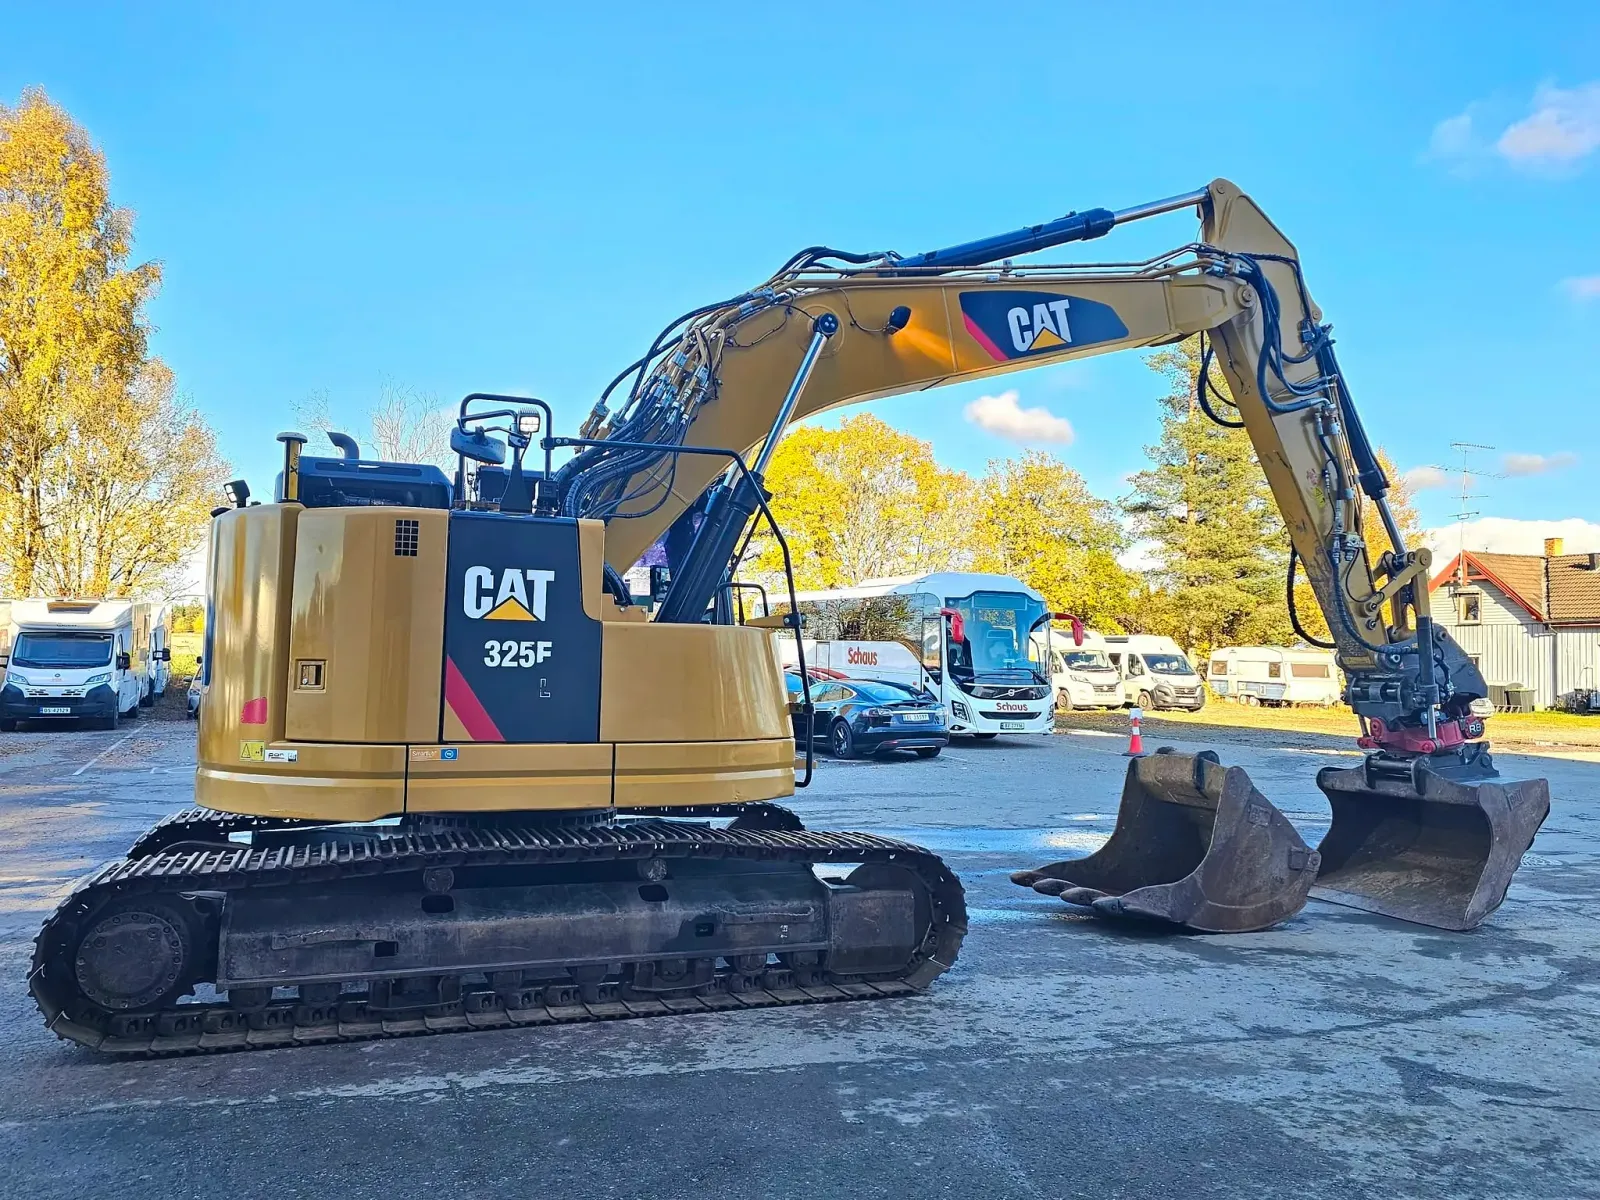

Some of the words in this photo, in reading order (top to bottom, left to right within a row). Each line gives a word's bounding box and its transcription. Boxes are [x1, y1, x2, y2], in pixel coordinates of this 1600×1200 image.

[1007, 299, 1072, 352] CAT
[463, 565, 555, 622] CAT
[484, 640, 553, 668] 325F
[848, 645, 878, 666] Schaus
[996, 701, 1028, 711] Schaus
